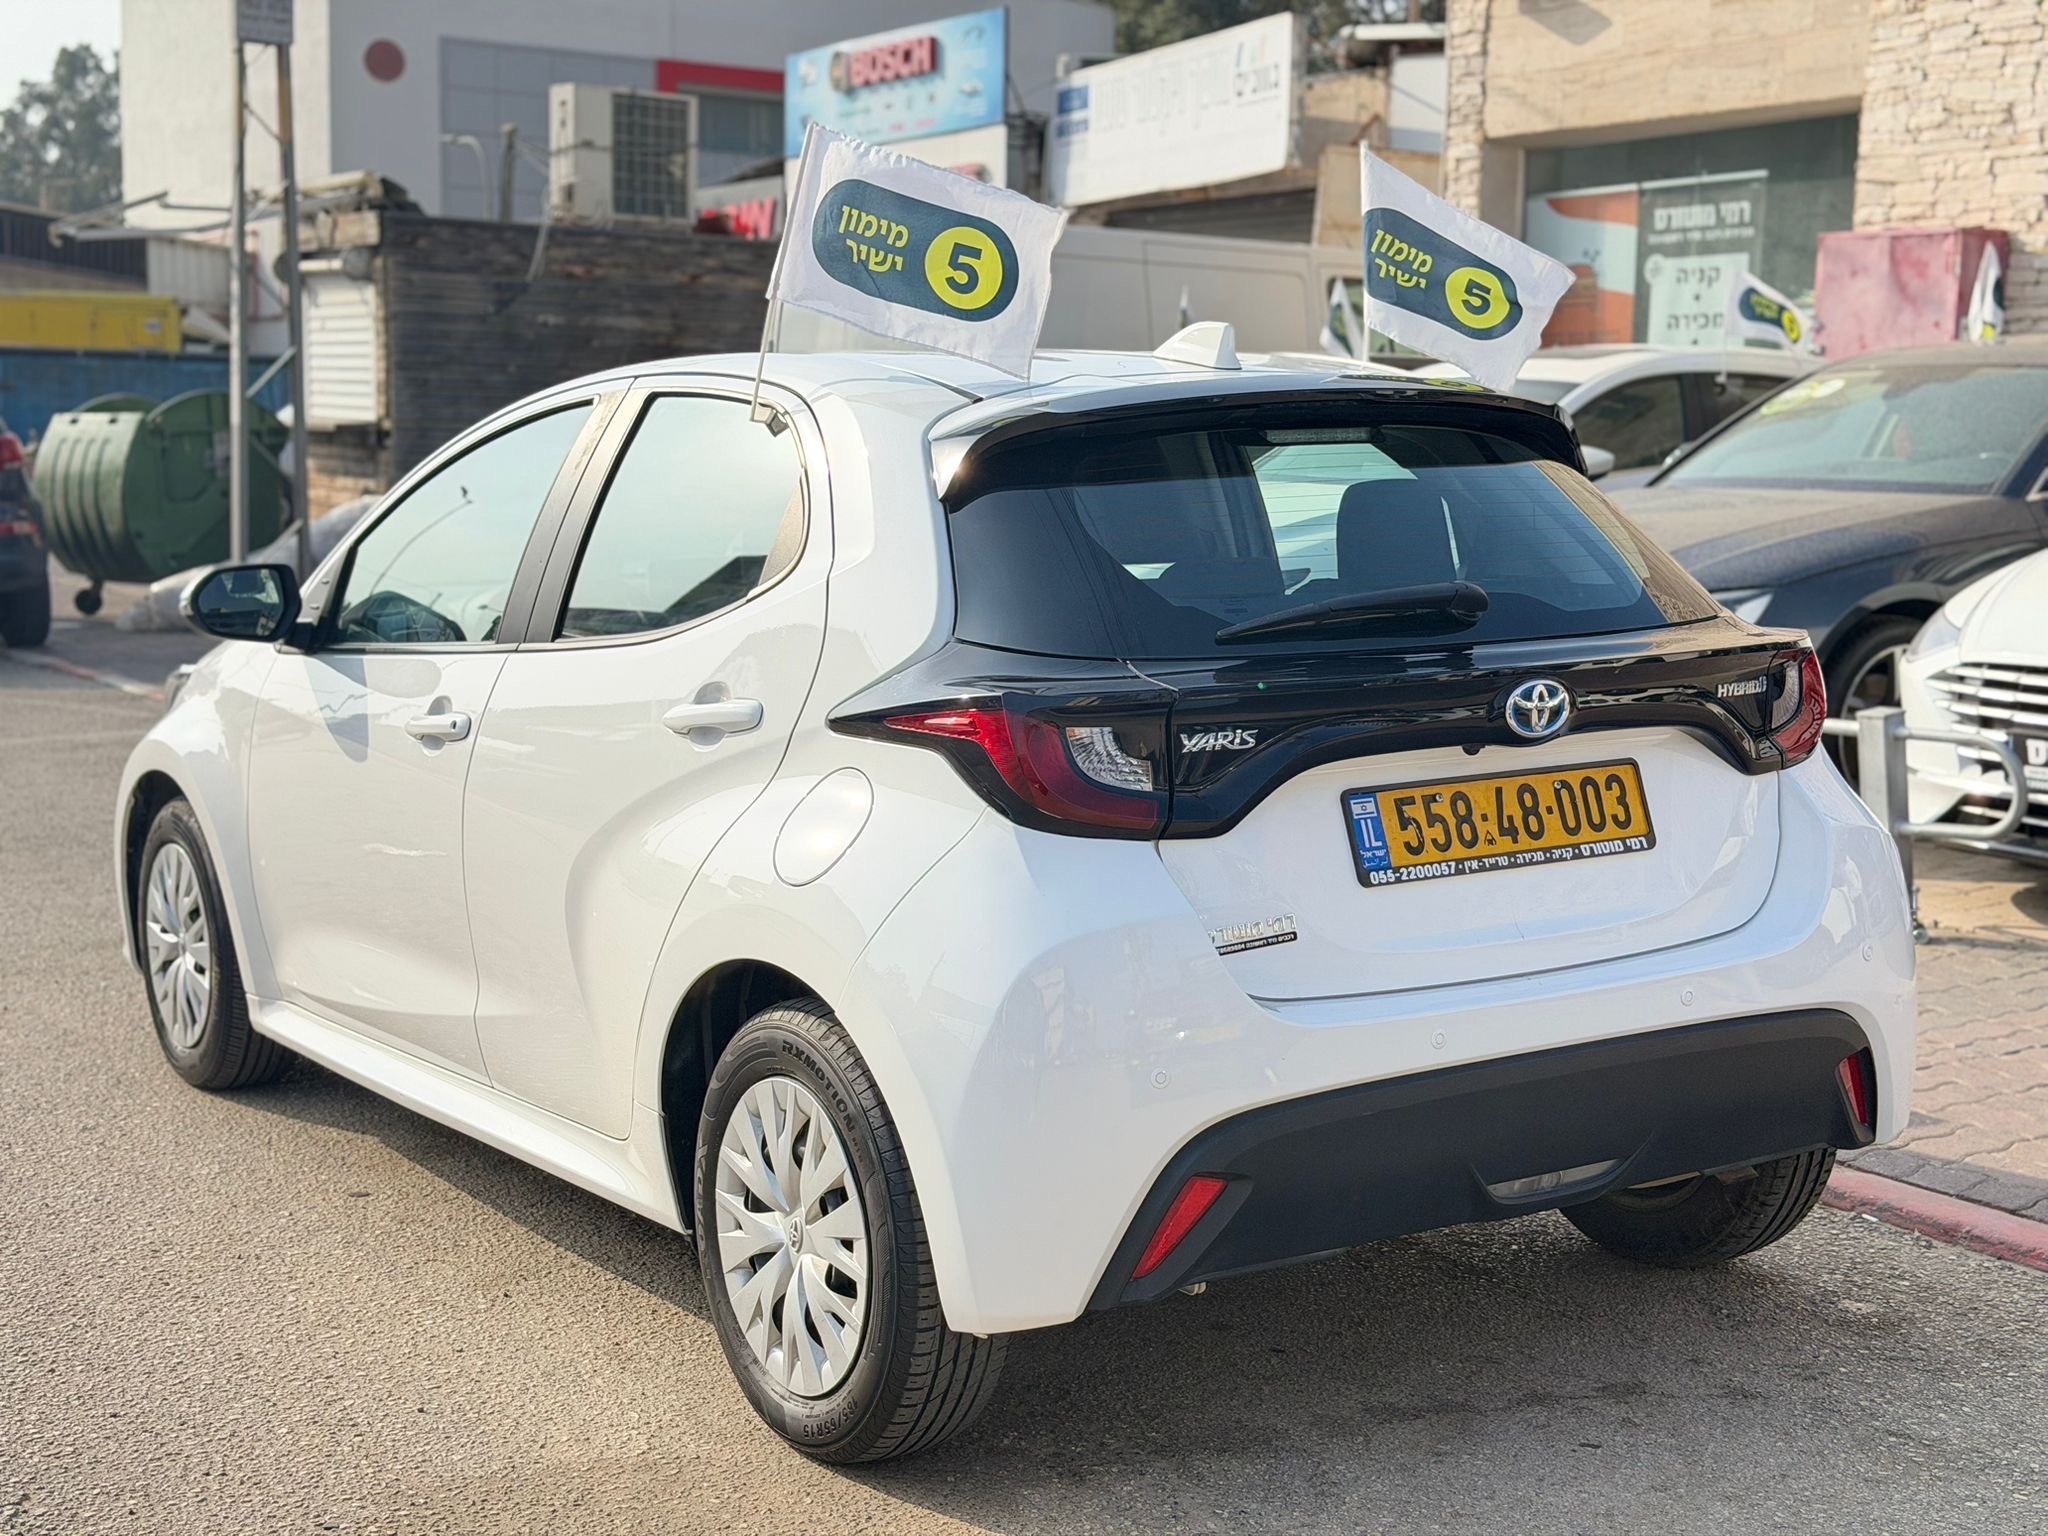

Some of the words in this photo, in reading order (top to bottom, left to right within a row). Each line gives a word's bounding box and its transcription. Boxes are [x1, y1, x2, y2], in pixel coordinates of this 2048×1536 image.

[850, 36, 935, 88] BOSCH
[838, 204, 909, 248] מימון
[846, 239, 904, 273] ישיר
[1370, 229, 1433, 273] מימון
[944, 241, 983, 295] 5
[1374, 258, 1427, 290] ישיר
[1675, 266, 1720, 289] קניה
[1461, 278, 1492, 316] 5
[1361, 819, 1383, 848] IL
[1580, 839, 1624, 856] מוטורס
[1626, 836, 1648, 849] רמי
[1360, 849, 1387, 859] ישראל
[1464, 855, 1509, 873] טרייד-אין
[1516, 850, 1545, 864] מכירה
[1552, 847, 1573, 860] קניה
[1370, 861, 1456, 884] 055-2200057
[782, 1040, 855, 1132] RXMOTION
[803, 1396, 858, 1438] 185/65R15
